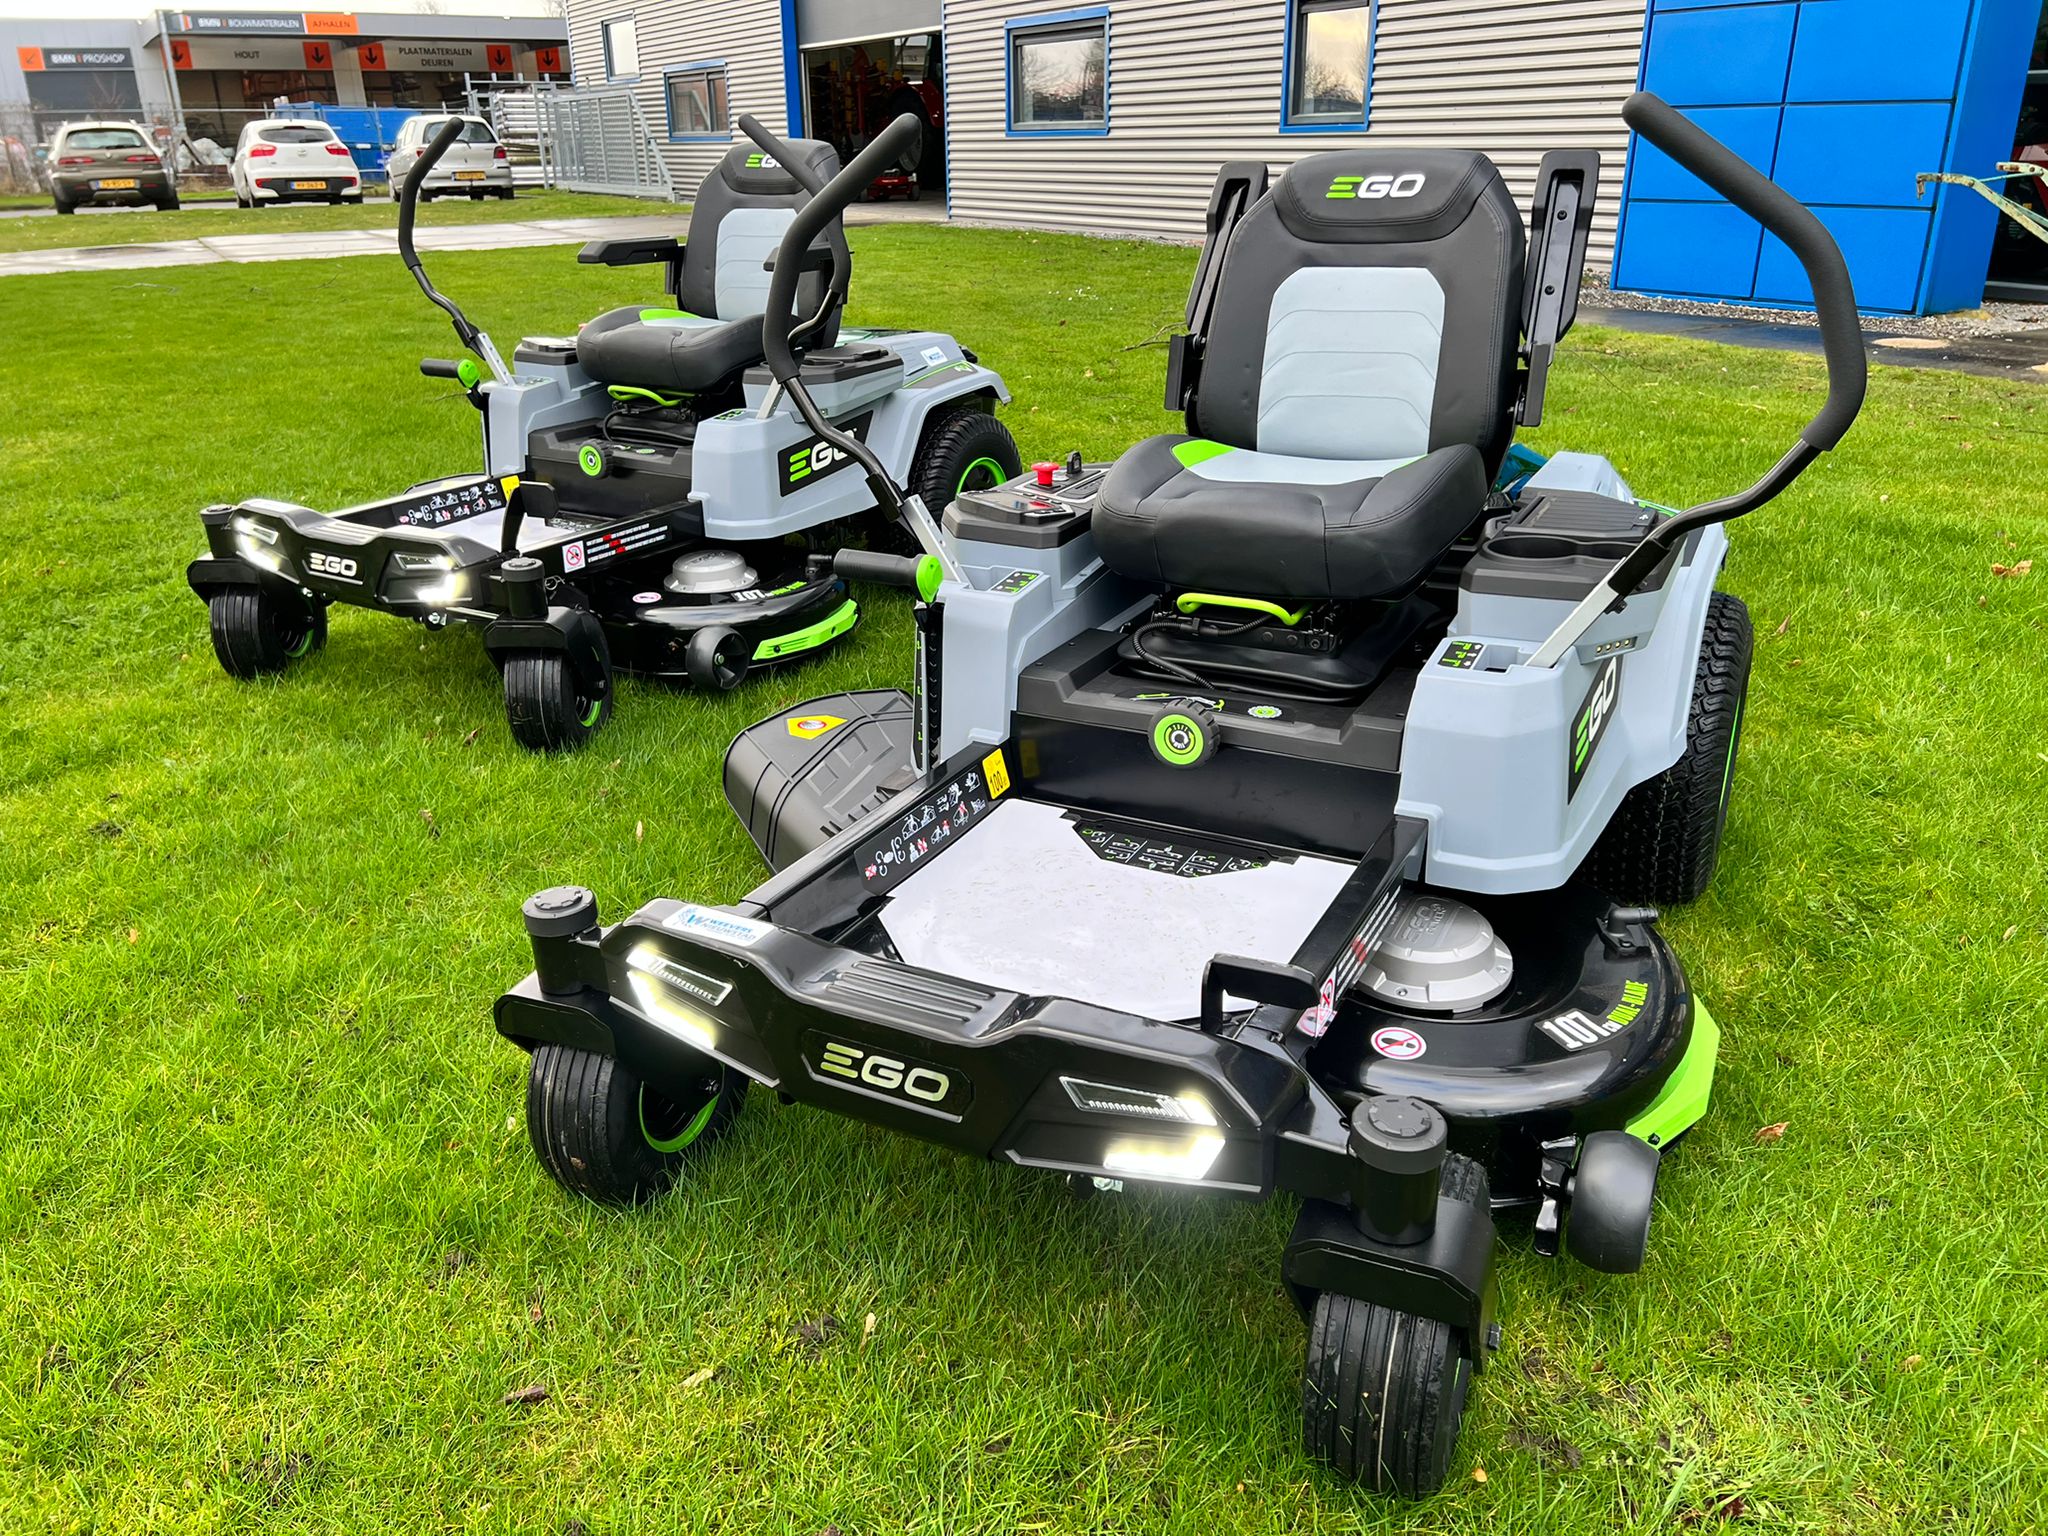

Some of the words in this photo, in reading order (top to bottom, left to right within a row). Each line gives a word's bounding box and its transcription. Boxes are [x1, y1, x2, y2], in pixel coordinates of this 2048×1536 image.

[229, 18, 300, 29] BOUWMATERIALEN
[83, 53, 126, 64] PROSHOP
[234, 51, 260, 60] HOUT
[399, 47, 473, 57] PLAATMATERIALEN
[421, 58, 454, 67] DEUREN
[745, 153, 783, 169] EG
[1325, 173, 1426, 199] EGO
[310, 552, 358, 578] EGO
[1574, 656, 1617, 774] EGO
[1542, 1010, 1612, 1049] 107
[820, 1042, 950, 1102] EGO
